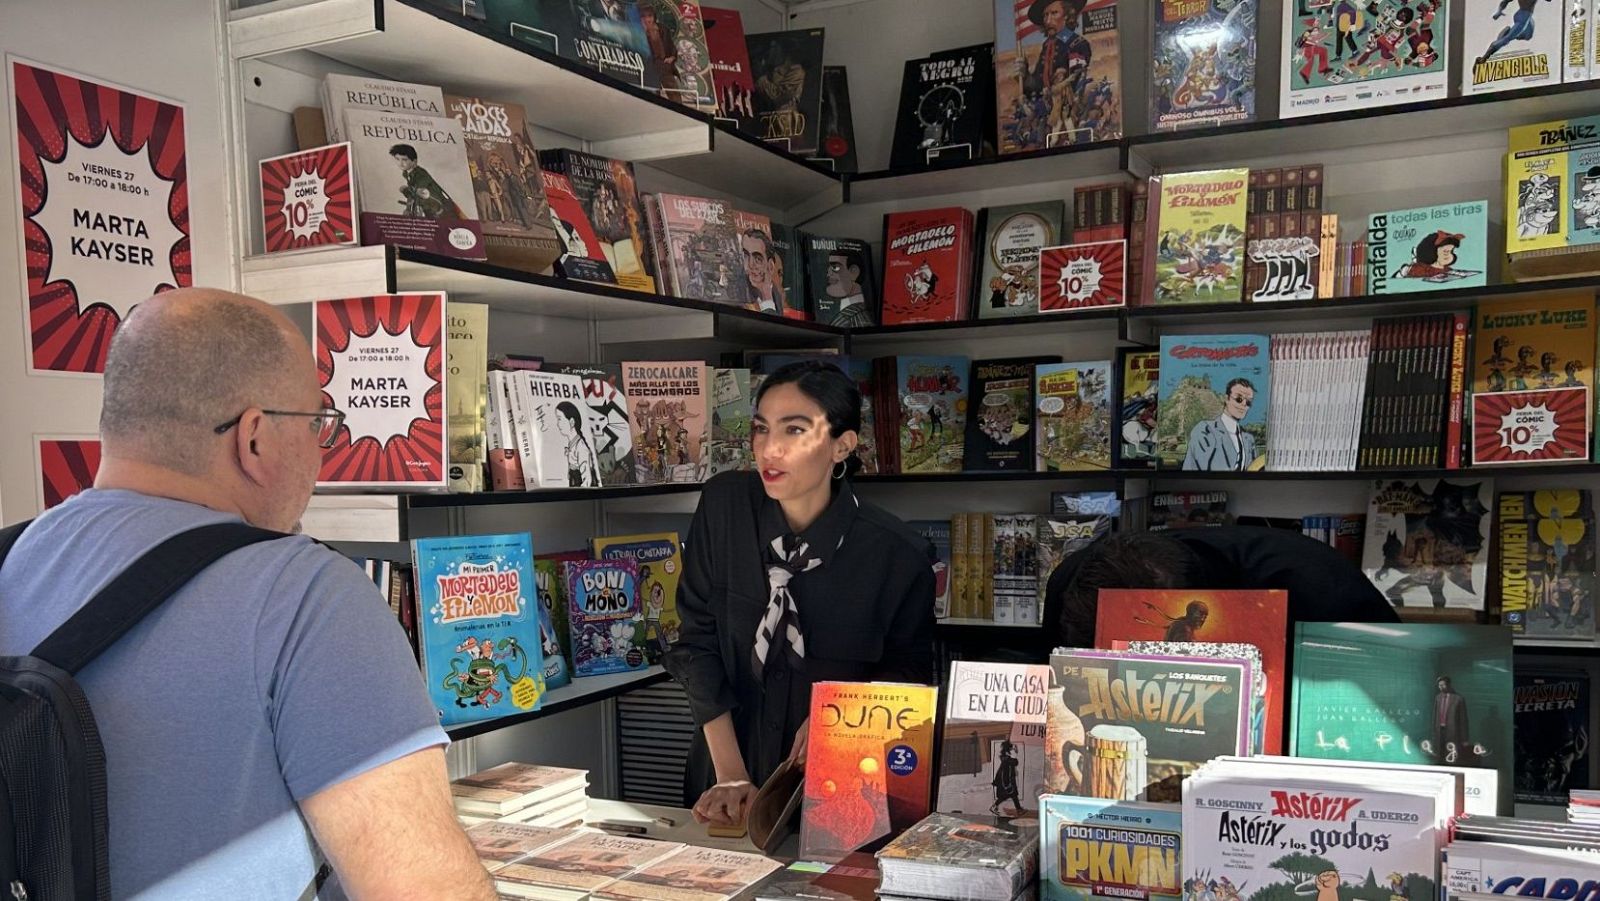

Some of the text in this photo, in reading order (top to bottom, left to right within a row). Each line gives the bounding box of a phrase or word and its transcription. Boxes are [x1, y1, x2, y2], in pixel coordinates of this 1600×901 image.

[573, 38, 645, 71] CONTRAPASO
[919, 56, 976, 71] TODO AL
[919, 65, 975, 82] NEGRO
[1473, 54, 1549, 85] INVENCIBLE
[346, 90, 440, 113] REPÚBLICA
[460, 102, 508, 121] VOCES
[1159, 111, 1192, 121] OMINOSO
[1192, 107, 1224, 119] OMNIBUS
[362, 123, 457, 144] REPÚBLICA
[1539, 124, 1597, 145] IBÁÑEZ
[82, 162, 135, 181] VIERNES 27
[68, 172, 150, 196] De 17:00 a 18:00 h
[295, 186, 317, 198] CÓMIC
[73, 208, 149, 239] MARTA
[1391, 203, 1482, 225] todas las tiras
[812, 239, 837, 251] BUÑUEL
[891, 225, 955, 250] MORTADELO
[70, 236, 154, 266] KAYSER
[1368, 214, 1388, 295] mafalda
[1071, 267, 1093, 275] CÓMIC
[1483, 309, 1588, 330] LUCKY LUKE
[628, 367, 698, 379] ZEROCALCARE
[351, 377, 408, 390] MARTA
[530, 381, 580, 399] HIERBA
[628, 388, 700, 396] ESCOMBROS
[348, 396, 411, 408] KAYSER
[1516, 416, 1544, 424] CÓMIC
[1066, 501, 1107, 513] JSA
[1154, 493, 1227, 507] ENNIS DILLON
[1055, 525, 1095, 539] JSA
[463, 565, 495, 574] MI PRIMER
[1502, 522, 1528, 612] WATCHMEN
[439, 571, 518, 599] MORTADELO
[582, 570, 626, 593] BONI
[443, 592, 518, 620] FILEMÓN
[585, 592, 628, 611] MONO
[984, 673, 1045, 695] UNA CASA
[1169, 672, 1228, 683] LOS BANQUETES
[863, 693, 909, 701] HERBERT'S
[968, 694, 988, 712] EN
[993, 694, 1010, 713] LA
[1063, 666, 1225, 727] DE Astérix
[1515, 700, 1576, 712] ECRETA
[821, 703, 920, 732] DUNE
[1352, 715, 1406, 723] GALLEGO
[1366, 706, 1421, 716] GALLEGO
[1315, 730, 1488, 762] La Plaga
[1195, 798, 1264, 811] R. GOSCINNY
[1270, 790, 1364, 823] Astérix
[1096, 813, 1142, 823] HÉCTOR HIERRO
[1358, 810, 1419, 822] A. UDERZO
[1066, 826, 1175, 847] 1001 CURIOSIDADES
[1218, 811, 1287, 847] Astérix
[1280, 820, 1392, 855] y los godos
[1065, 838, 1175, 889] PKMN
[1104, 886, 1145, 899] GENERACIÓN
